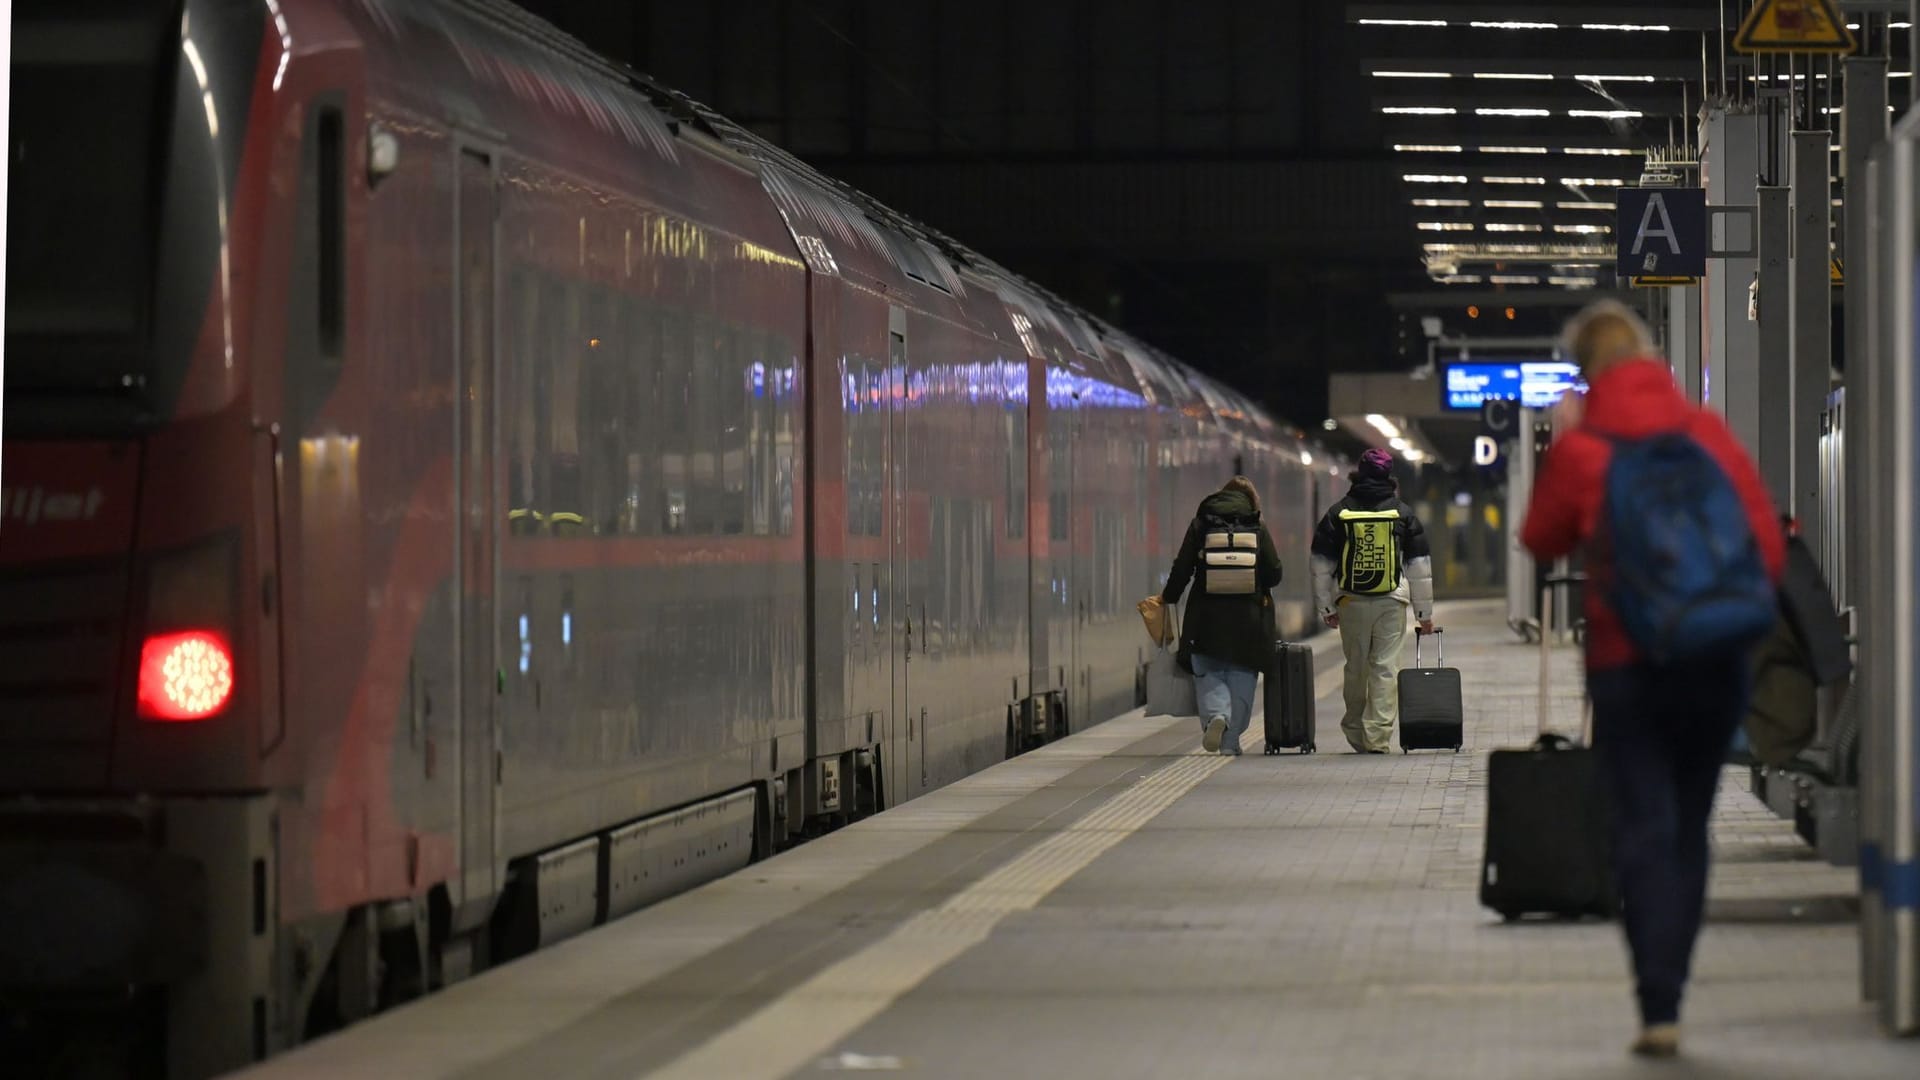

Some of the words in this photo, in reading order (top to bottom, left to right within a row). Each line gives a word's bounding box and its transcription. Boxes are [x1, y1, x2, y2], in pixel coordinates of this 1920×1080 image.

[1631, 192, 1681, 254] A
[1486, 399, 1509, 430] C
[1474, 435, 1498, 466] D
[1354, 537, 1364, 569] FACE
[1364, 524, 1375, 569] NORTH
[1375, 544, 1385, 569] THE
